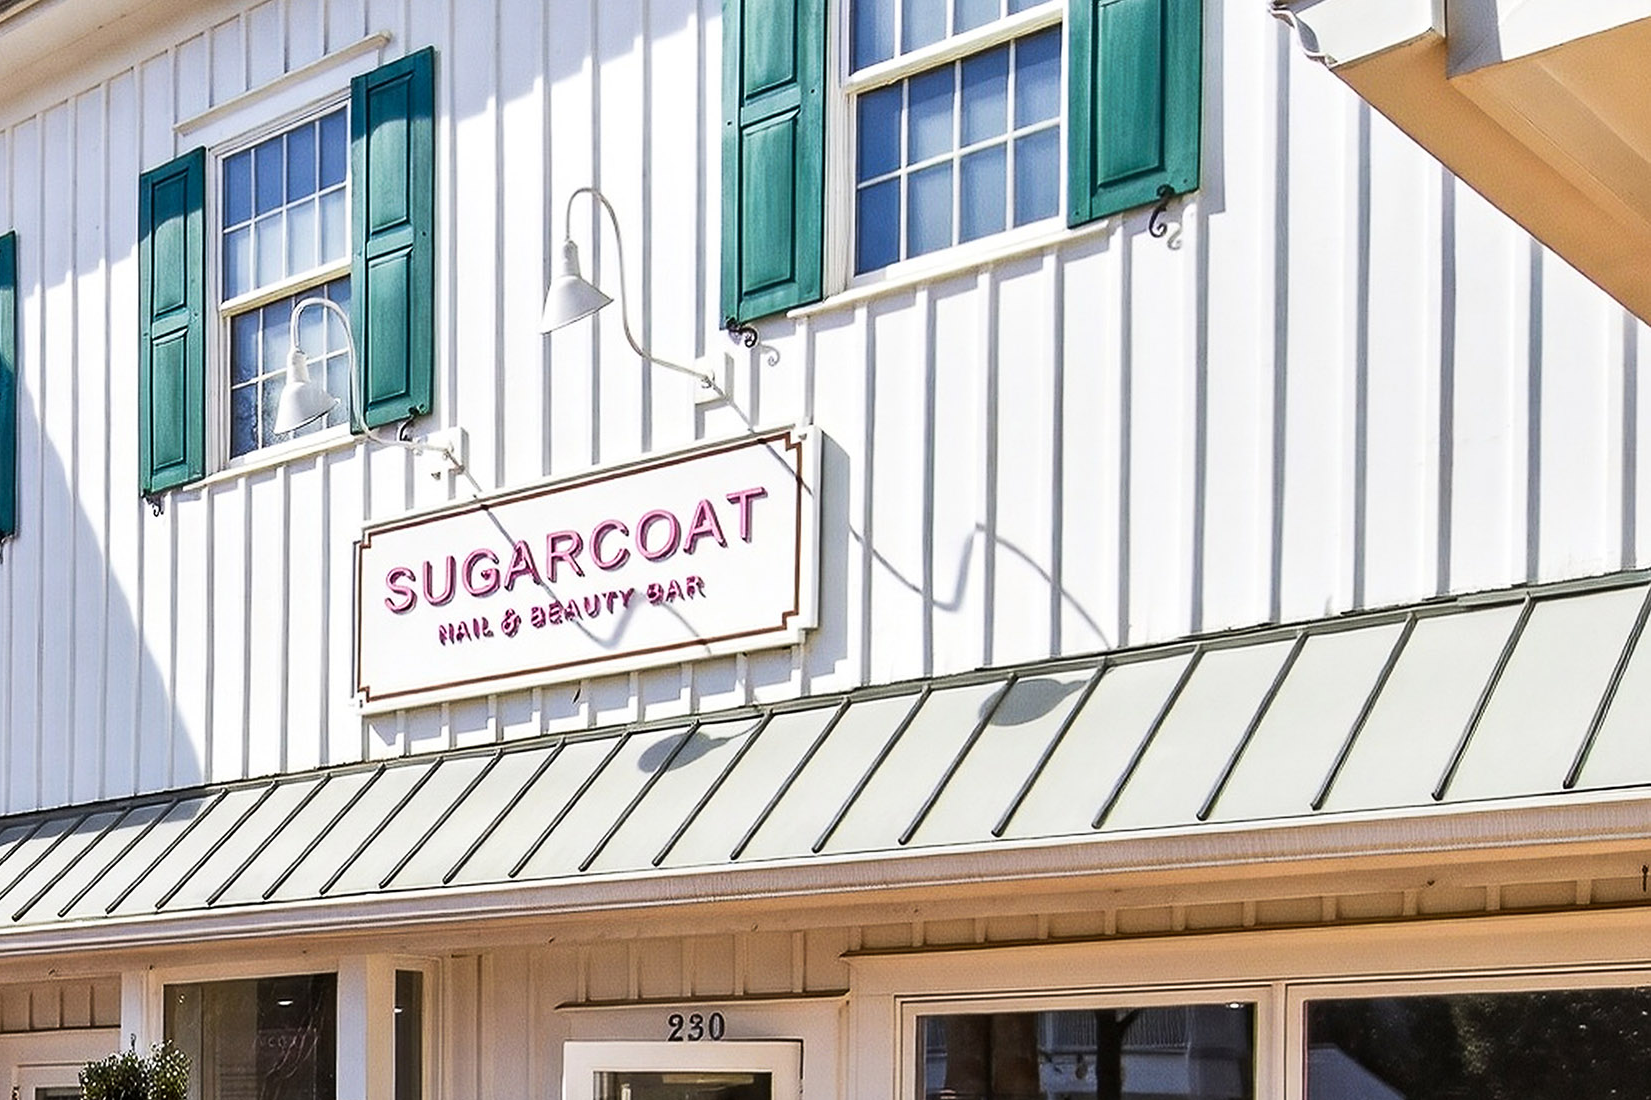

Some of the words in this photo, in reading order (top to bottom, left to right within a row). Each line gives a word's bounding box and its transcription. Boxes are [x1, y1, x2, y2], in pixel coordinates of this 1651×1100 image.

[384, 486, 769, 615] SUGARCOAT
[438, 613, 495, 646] NAIL
[500, 609, 522, 638] &
[530, 587, 635, 629] BEAUTY
[647, 575, 707, 606] BAR
[667, 1012, 725, 1041] 230
